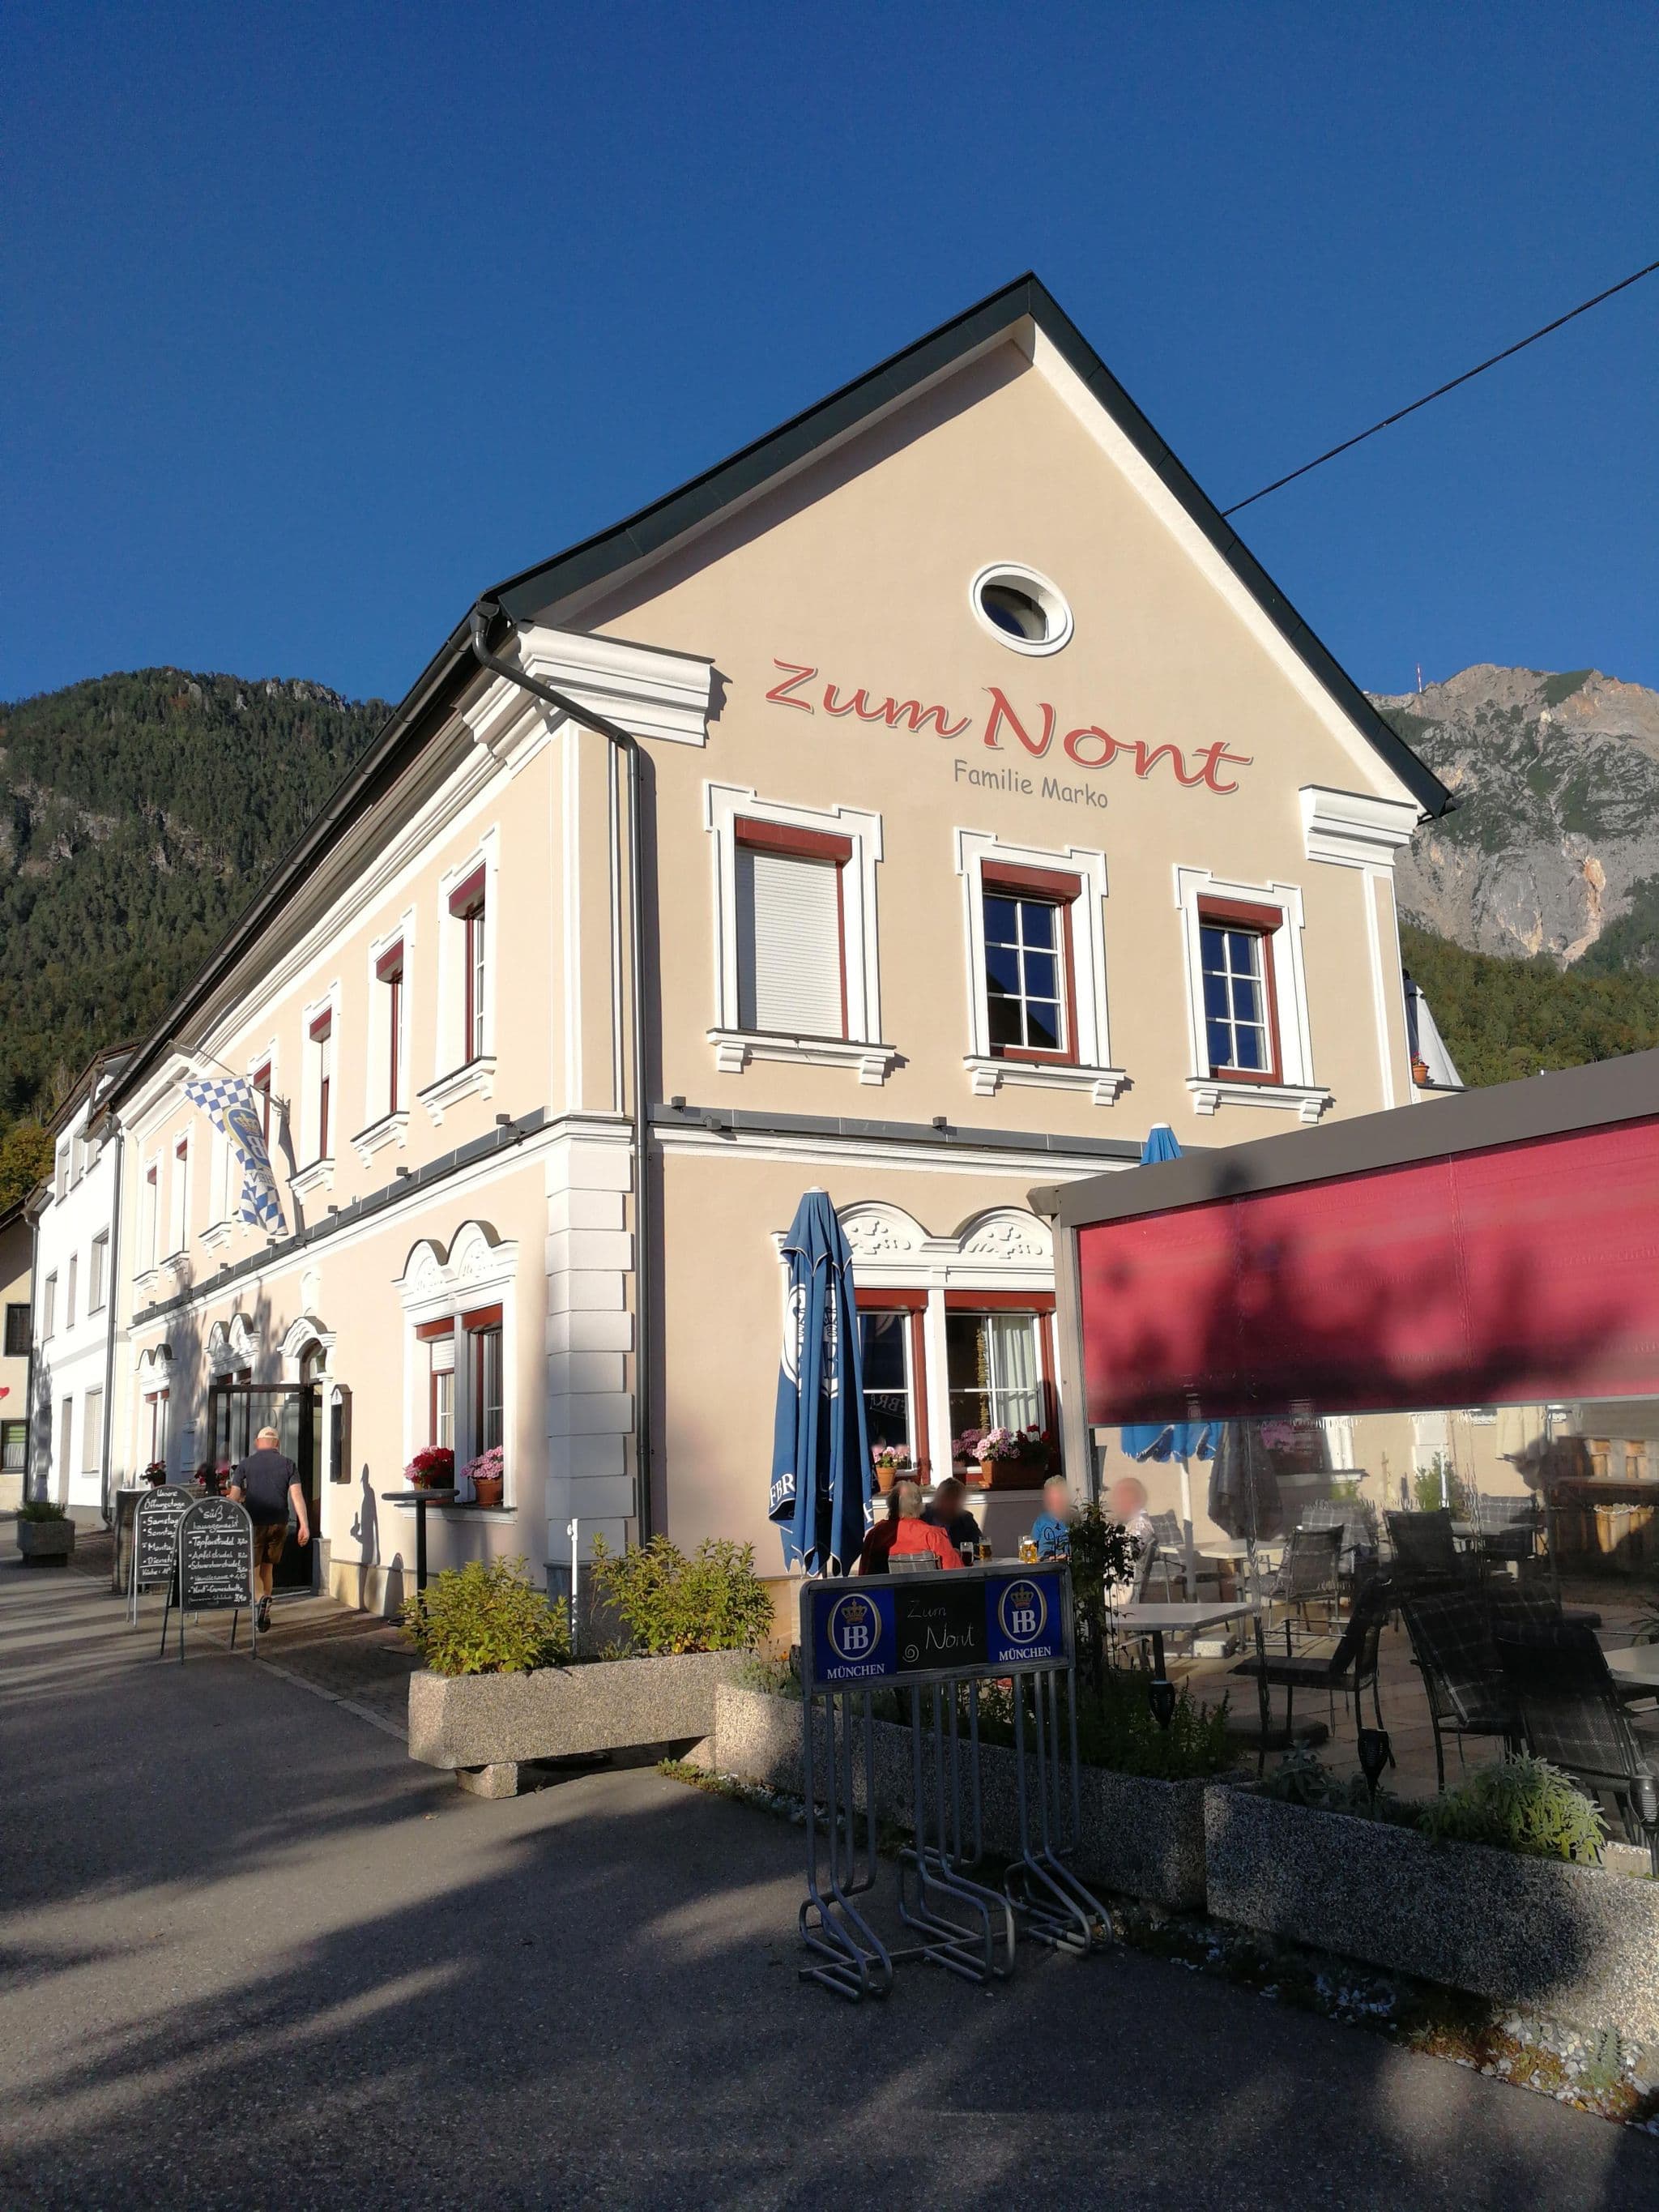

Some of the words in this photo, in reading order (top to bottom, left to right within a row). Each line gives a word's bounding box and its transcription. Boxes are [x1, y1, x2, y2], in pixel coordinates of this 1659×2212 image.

[765, 658, 972, 738] Zum
[982, 685, 1253, 795] Nont
[954, 758, 1034, 796] Familie
[1042, 777, 1109, 809] Marko
[203, 1505, 224, 1522] süß
[907, 1600, 947, 1619] Zum
[1012, 1609, 1036, 1633] HB
[842, 1625, 868, 1650] HB
[999, 1646, 1051, 1662] MÜNCHEN
[827, 1663, 885, 1680] MÜNCHEN
